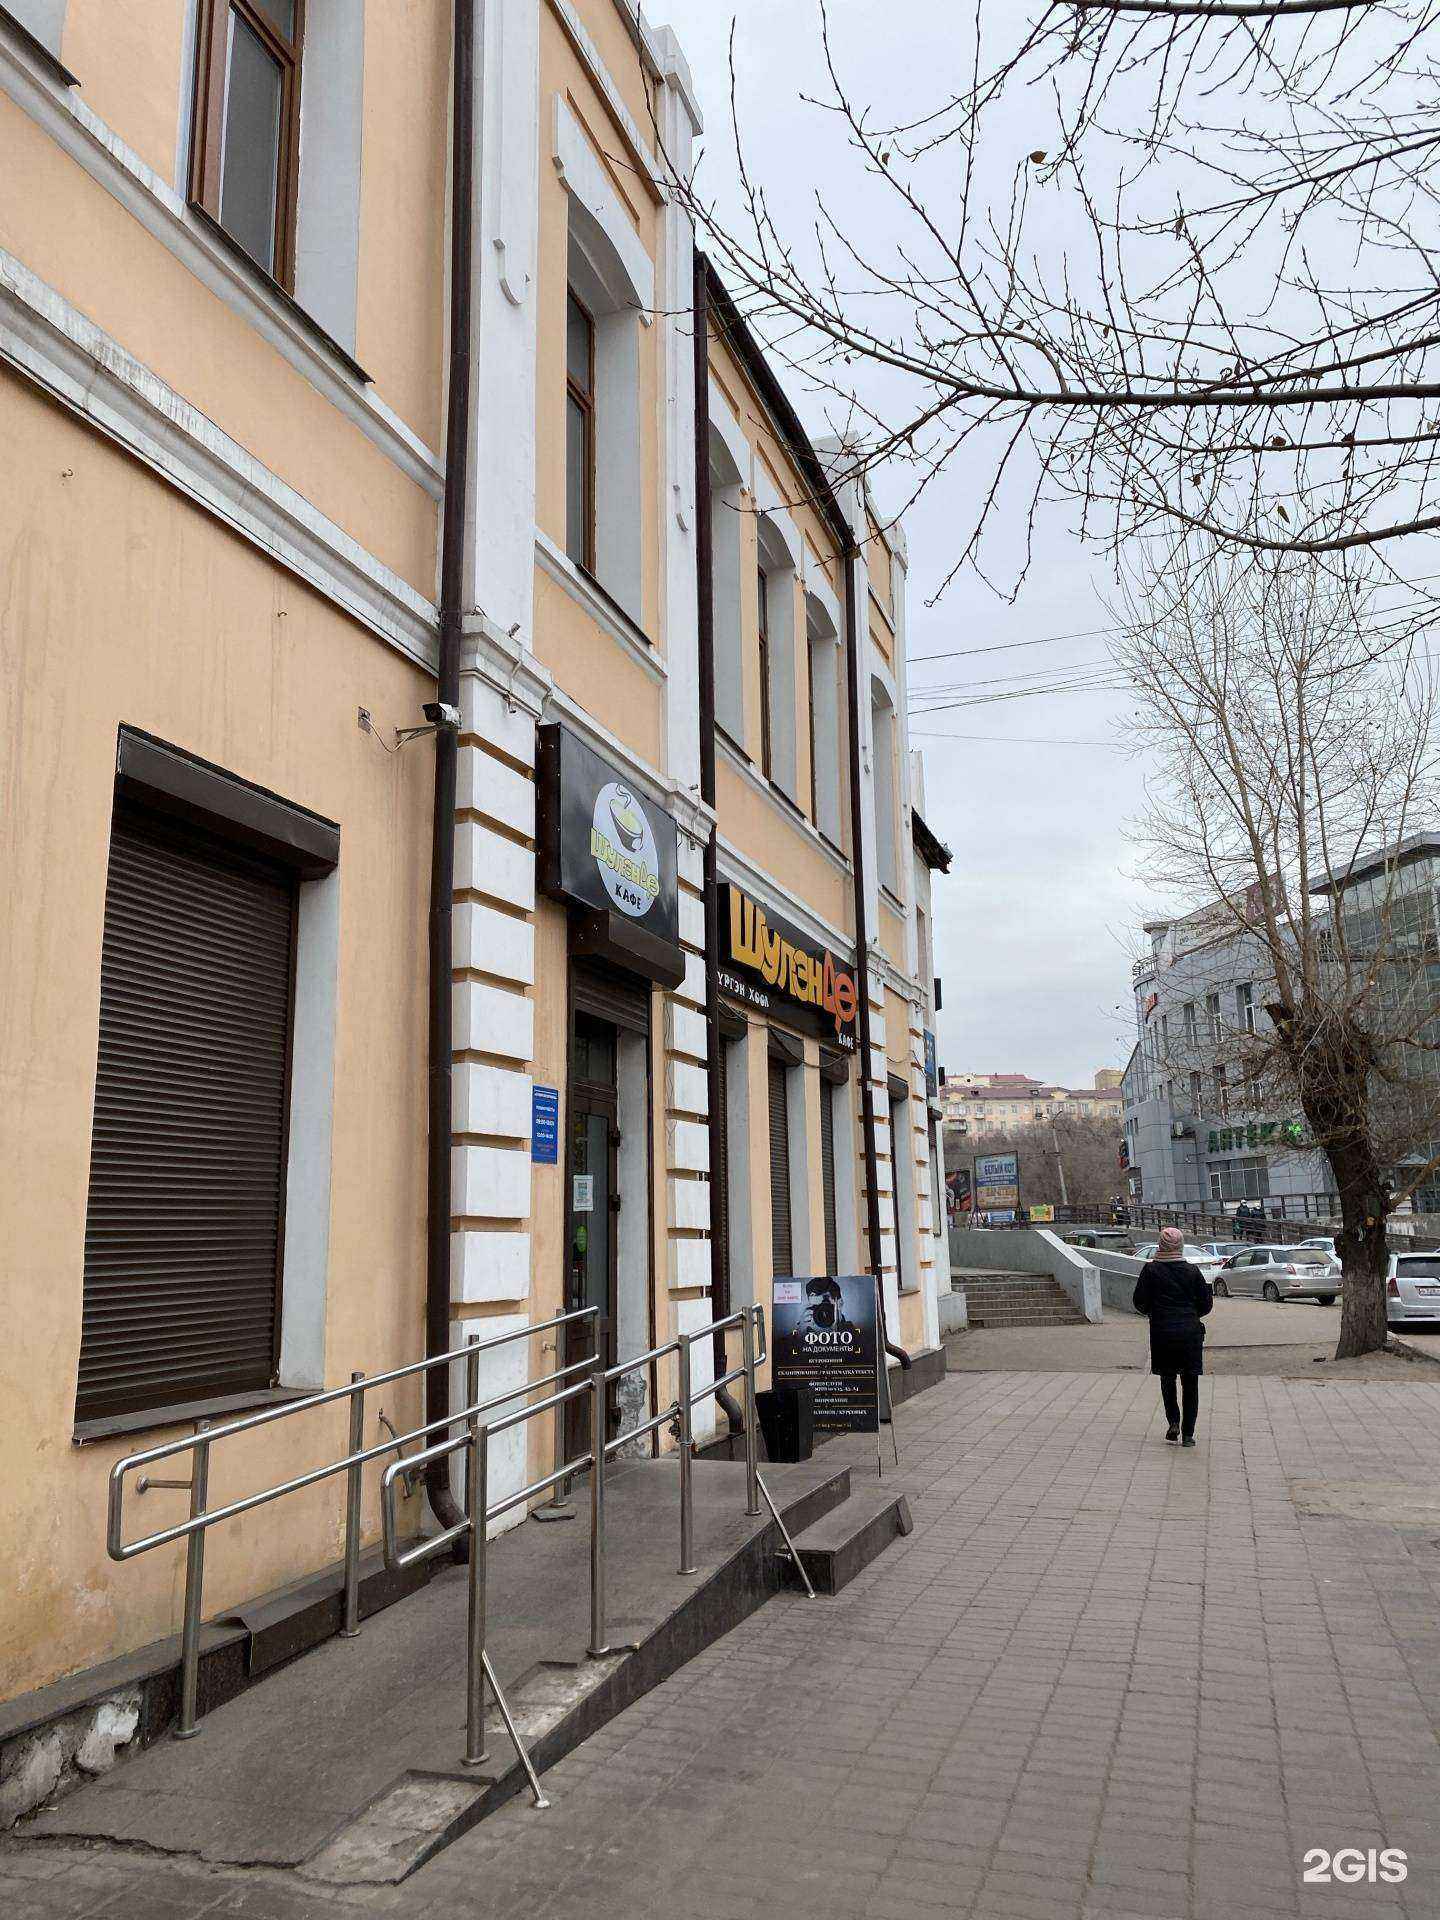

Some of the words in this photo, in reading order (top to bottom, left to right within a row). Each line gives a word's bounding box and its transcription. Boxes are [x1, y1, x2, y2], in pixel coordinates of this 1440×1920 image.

[615, 883, 641, 909] КАФЕ
[804, 1332, 853, 1345] ФОТО
[802, 1345, 812, 1353] НА
[813, 1345, 854, 1353] ДОКУМЕНТЫ
